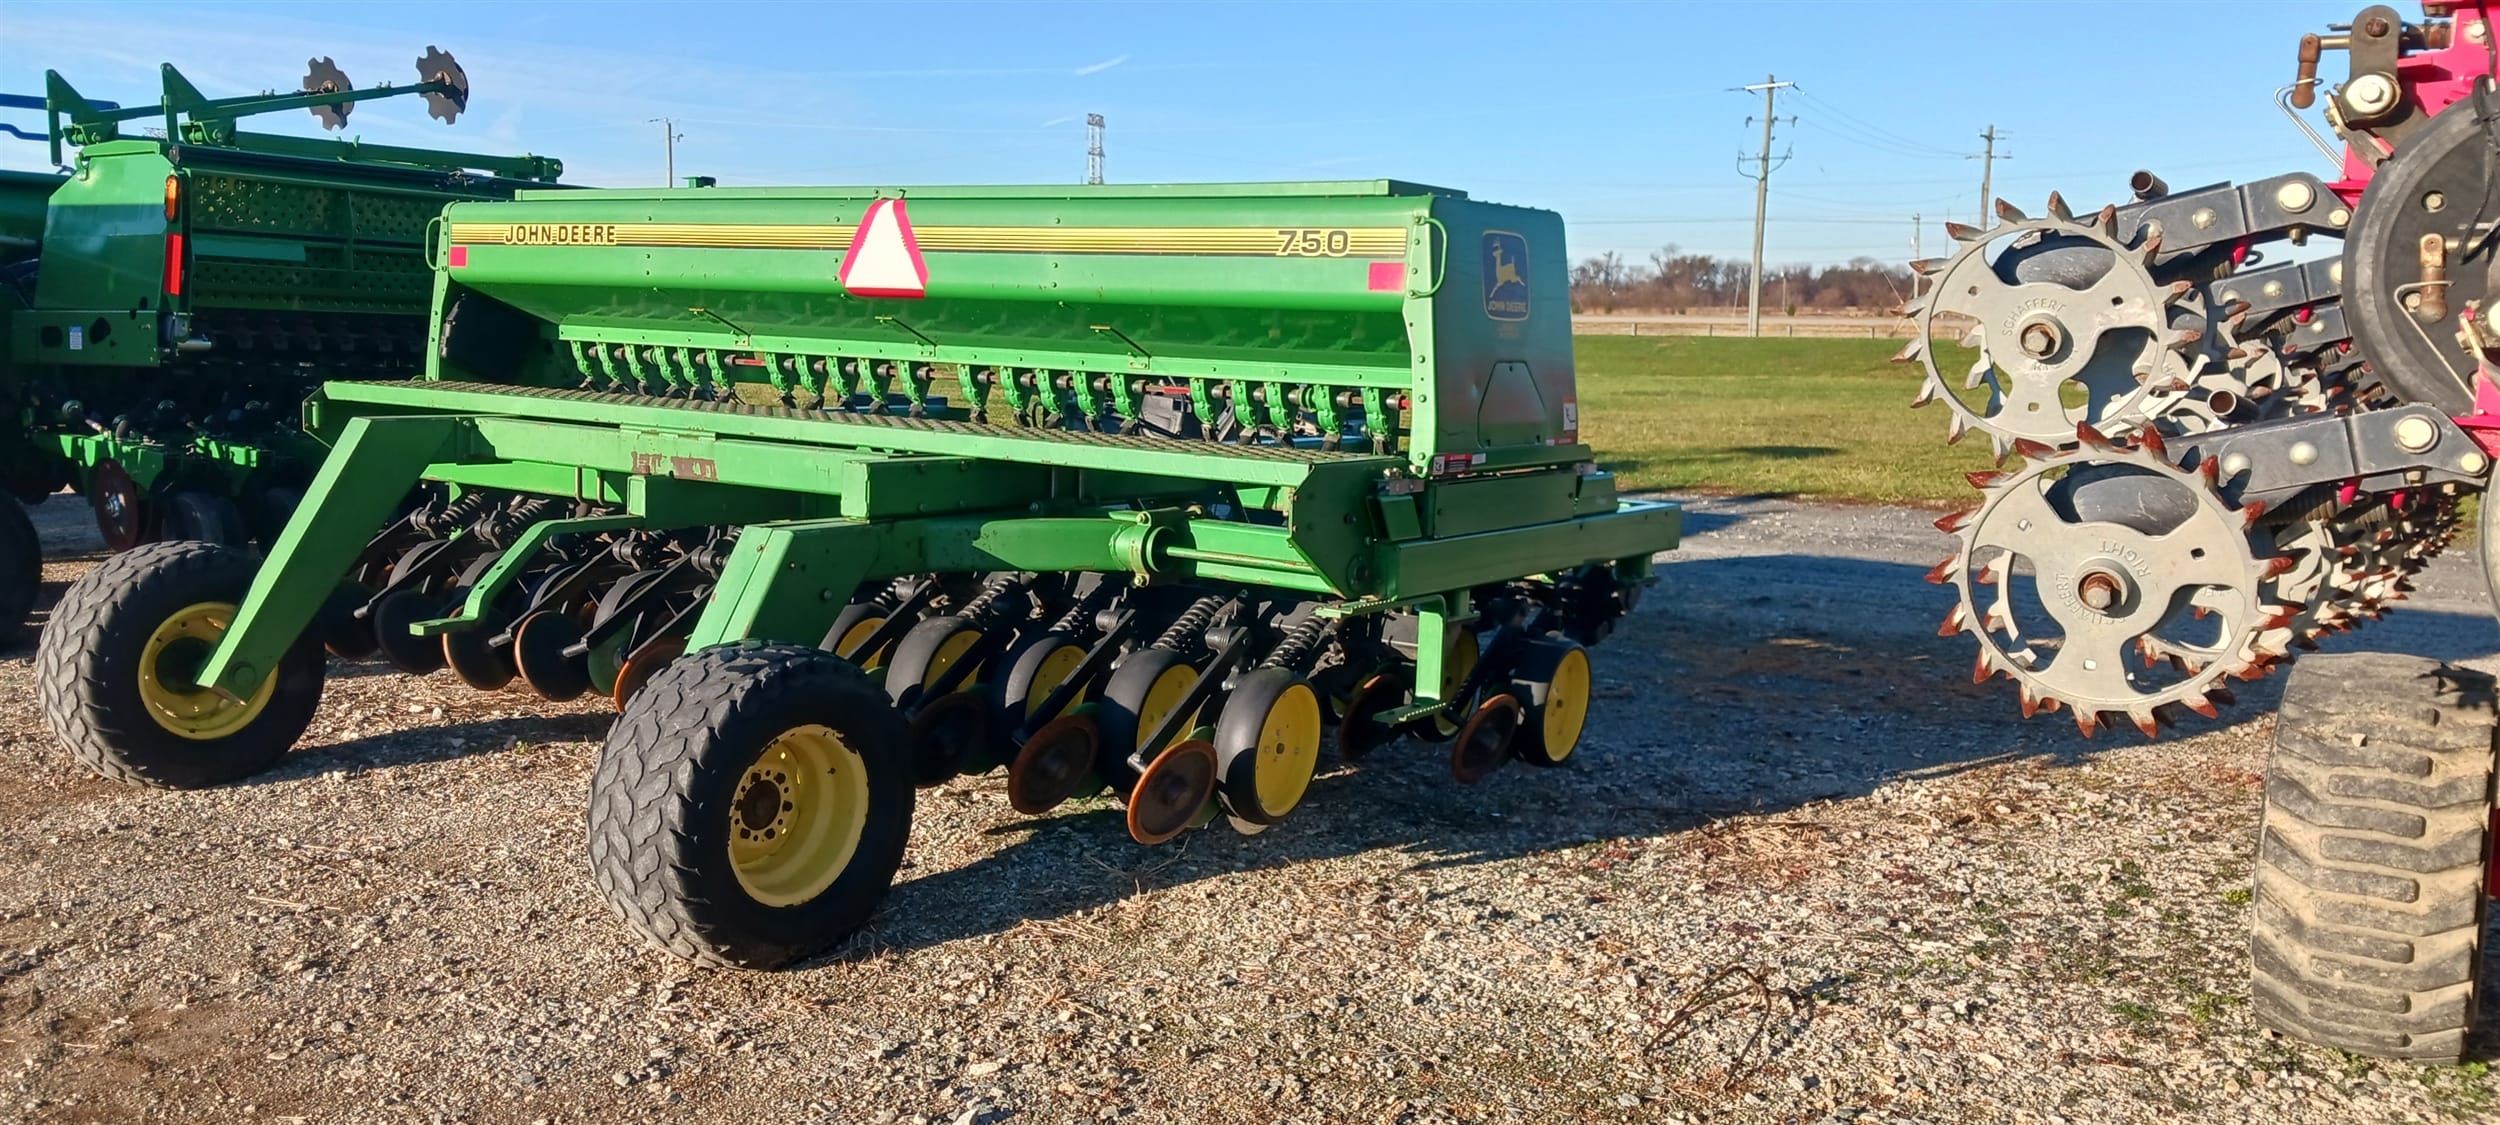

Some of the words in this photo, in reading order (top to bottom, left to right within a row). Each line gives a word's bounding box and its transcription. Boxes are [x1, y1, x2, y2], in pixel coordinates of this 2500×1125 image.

[505, 225, 552, 243] JOHN
[558, 225, 616, 243] DEERE
[1277, 229, 1349, 254] 750
[2098, 540, 2152, 578] RIGHT
